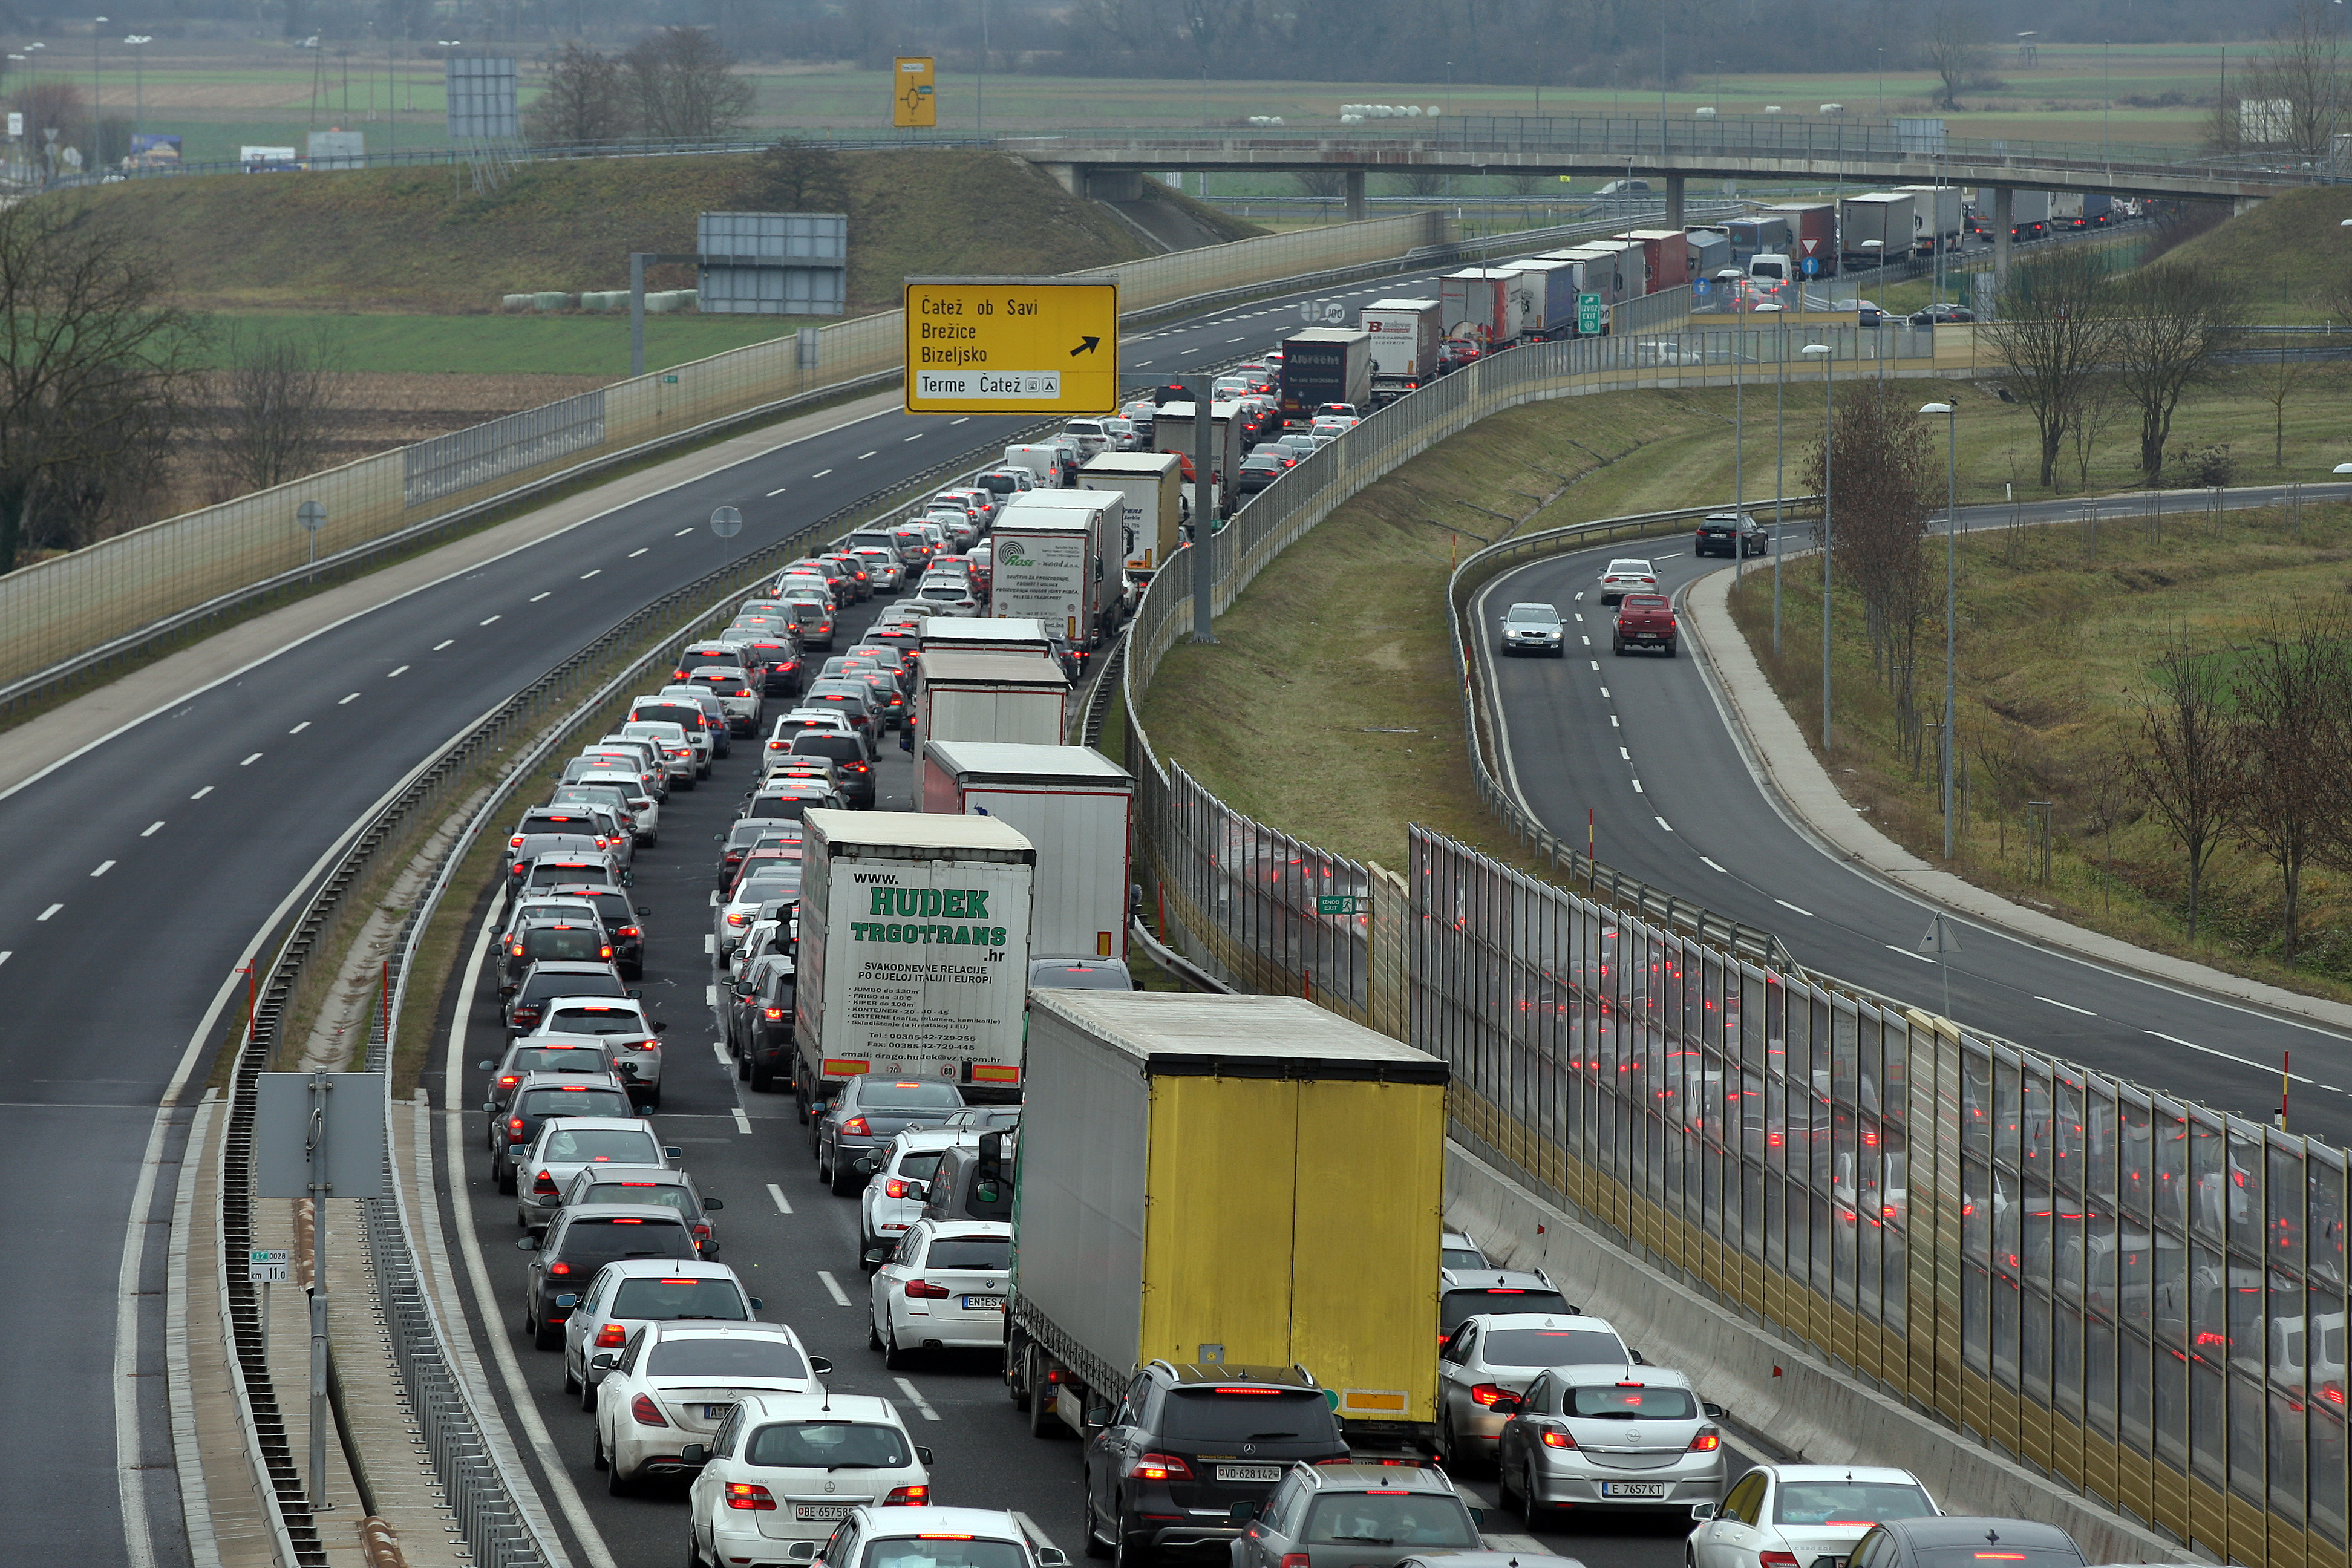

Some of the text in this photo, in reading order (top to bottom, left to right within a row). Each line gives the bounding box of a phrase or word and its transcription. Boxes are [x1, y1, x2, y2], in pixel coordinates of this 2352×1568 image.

[922, 295, 1037, 315] Čatež ob Savi
[922, 323, 976, 339] Brežice
[922, 346, 987, 365] Bizeljsko
[1290, 354, 1339, 365] Albrecht
[923, 373, 1021, 393] Terme Čatež
[854, 873, 898, 885] www.
[870, 887, 989, 919] HUDEK
[851, 922, 1007, 946] TRGOTRANS
[984, 949, 1005, 962] .hr
[865, 962, 987, 974] SVAKODNEVNE RELACIJE
[875, 973, 912, 981] CIJELOJ
[944, 1067, 953, 1076] 80
[269, 1267, 286, 1280] 11.0
[969, 1298, 980, 1306] EN
[985, 1298, 997, 1307] ES
[711, 1408, 717, 1417] A
